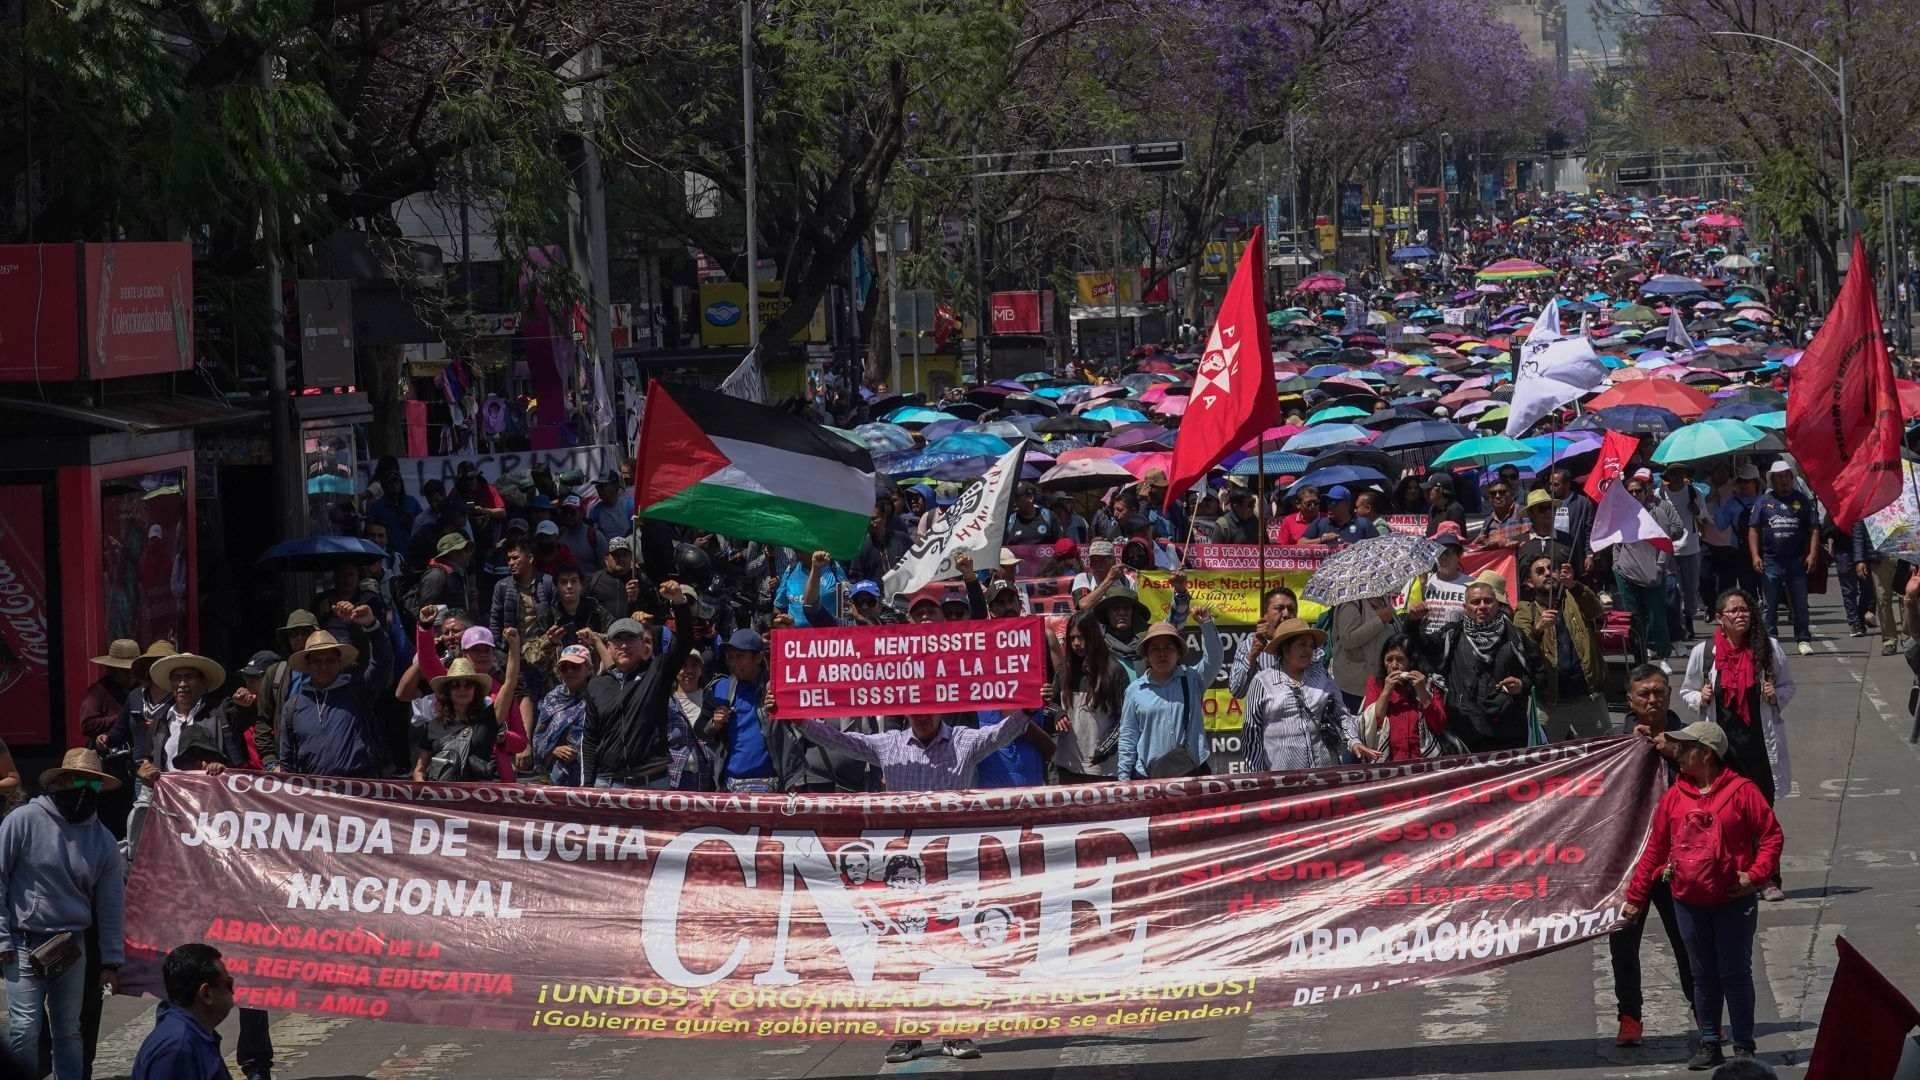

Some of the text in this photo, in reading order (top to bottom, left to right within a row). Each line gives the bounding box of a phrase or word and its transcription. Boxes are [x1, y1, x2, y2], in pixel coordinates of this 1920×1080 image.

[1205, 558, 1294, 569] TRABAJAORES
[1222, 546, 1311, 557] TRABAADORES
[785, 630, 1031, 659] CLAUDIA, MENTISSSTE CON
[785, 655, 1031, 683] LA ABROGACIÓN A LA LEY
[799, 680, 1020, 707] DEL ISSSTE DE 2007
[227, 774, 555, 806] COORDINADORA
[565, 788, 777, 813] NACIONAL
[859, 780, 1193, 813] TRABAJADORES
[1199, 777, 1261, 796] DE
[1271, 772, 1329, 788] LA
[181, 811, 648, 861] JORNADA DE LUCHA
[286, 872, 522, 919] NACIONAL
[641, 816, 1150, 988] CNTE
[206, 917, 441, 959] ABROGACIÓN DE LA
[254, 956, 371, 987] REFORMA
[377, 966, 515, 996] EDUCATIVA
[234, 985, 297, 1009] PEÑA
[319, 993, 389, 1017] AMLO
[538, 984, 690, 1008] ¡UNIDOS
[697, 990, 722, 1007] Y
[1293, 986, 1327, 1007] DE
[533, 1001, 1253, 1037] ¡Gobierne quien gobierne, los derechos se defienden!
